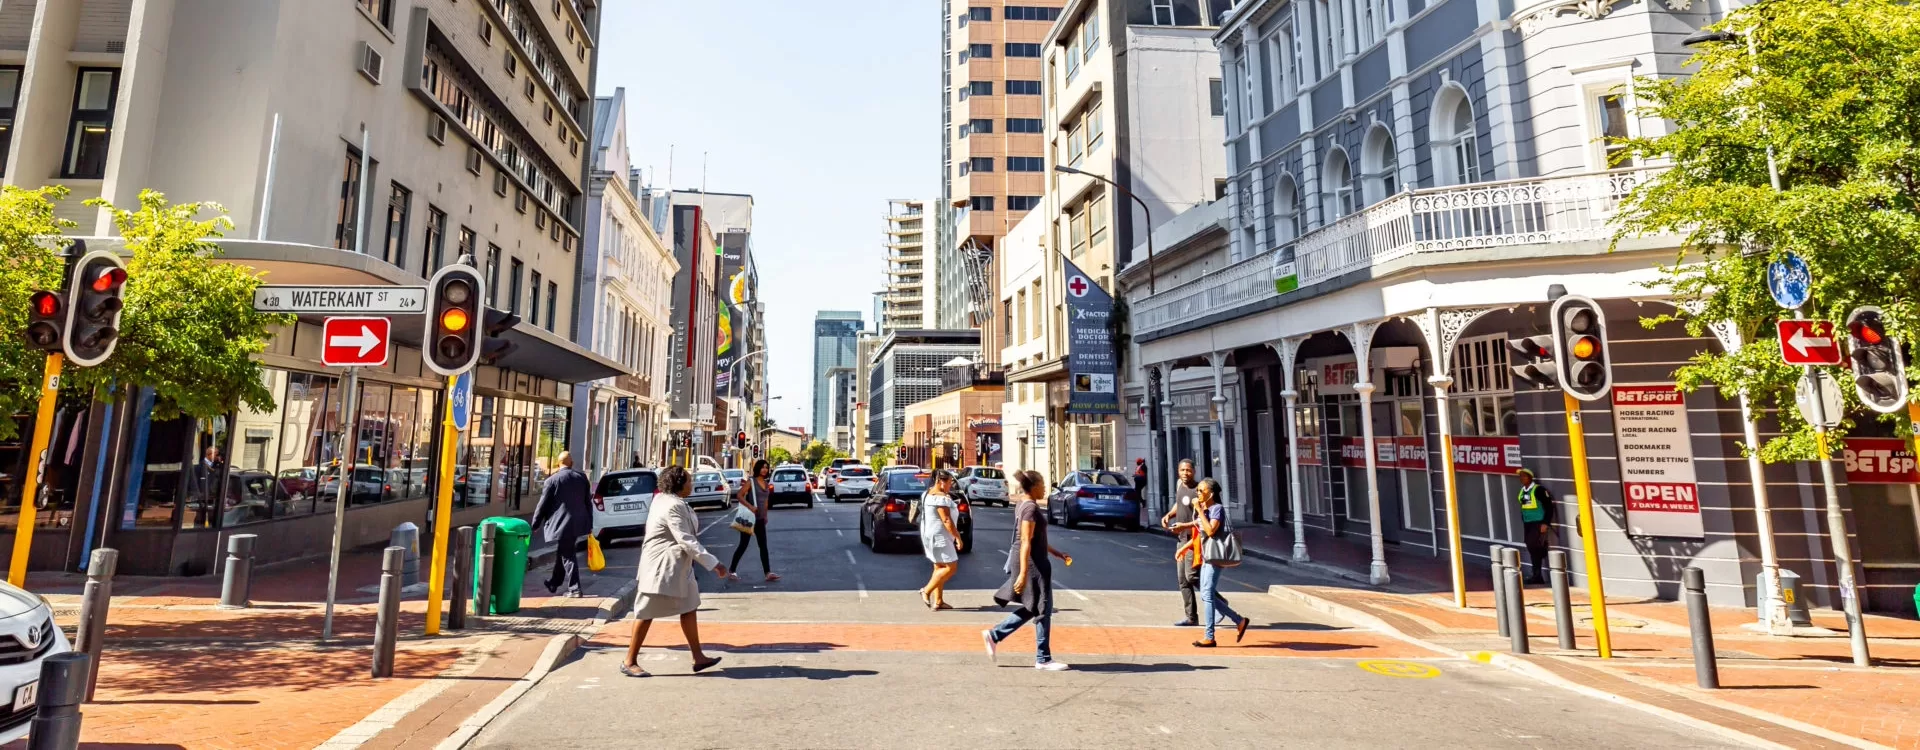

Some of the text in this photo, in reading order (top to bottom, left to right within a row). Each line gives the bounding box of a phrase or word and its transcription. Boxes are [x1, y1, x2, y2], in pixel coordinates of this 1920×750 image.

[1282, 265, 1290, 275] LET
[269, 290, 410, 308] 30 WATERKANT ST 24
[677, 320, 685, 353] STREET
[675, 358, 683, 384] LOOP
[51, 376, 59, 388] 3
[1616, 390, 1679, 402] BETSPORT
[1574, 411, 1580, 421] 5
[1912, 422, 1919, 433] 6
[1453, 445, 1499, 465] BETSPORT
[1843, 449, 1919, 474] BETSP
[1629, 484, 1694, 502] OPEN
